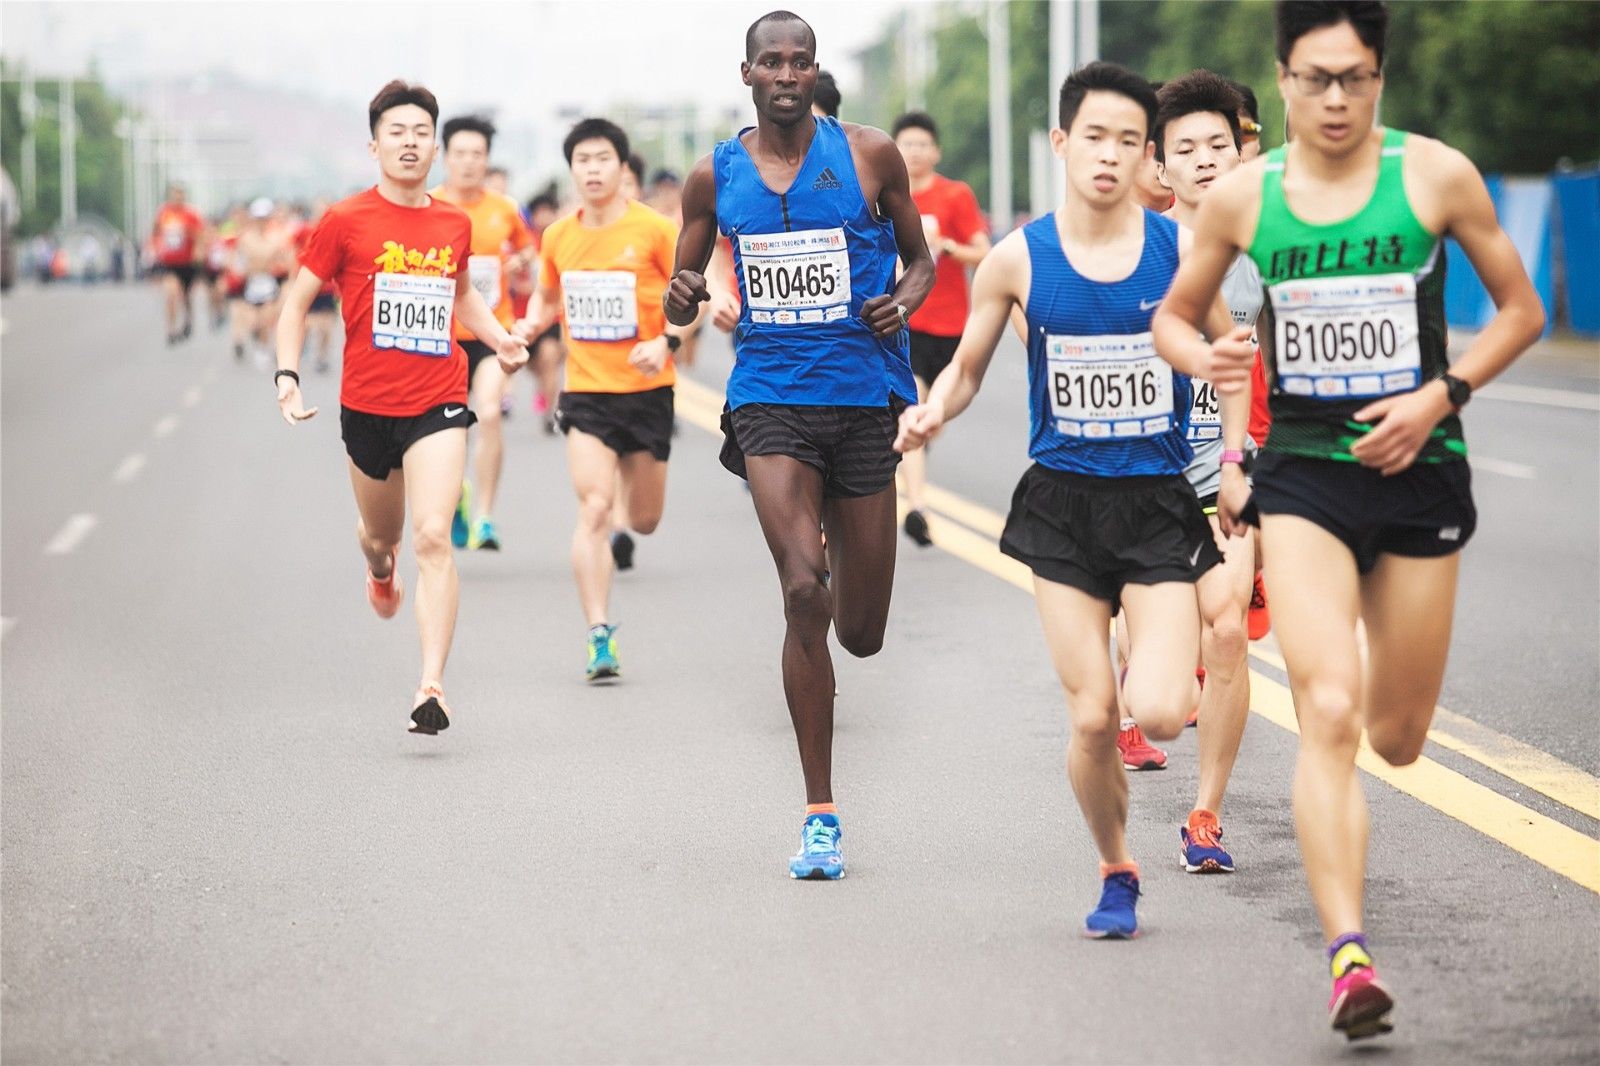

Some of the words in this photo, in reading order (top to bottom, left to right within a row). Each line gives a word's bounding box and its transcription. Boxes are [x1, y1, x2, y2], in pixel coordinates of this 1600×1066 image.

[812, 181, 843, 190] adidas
[752, 242, 768, 251] 2019
[1270, 235, 1407, 279] 康比特
[748, 263, 835, 299] B10465
[378, 300, 446, 331] B10416
[568, 296, 622, 319] B10103
[1285, 319, 1396, 362] B10500
[1055, 370, 1156, 409] B10516
